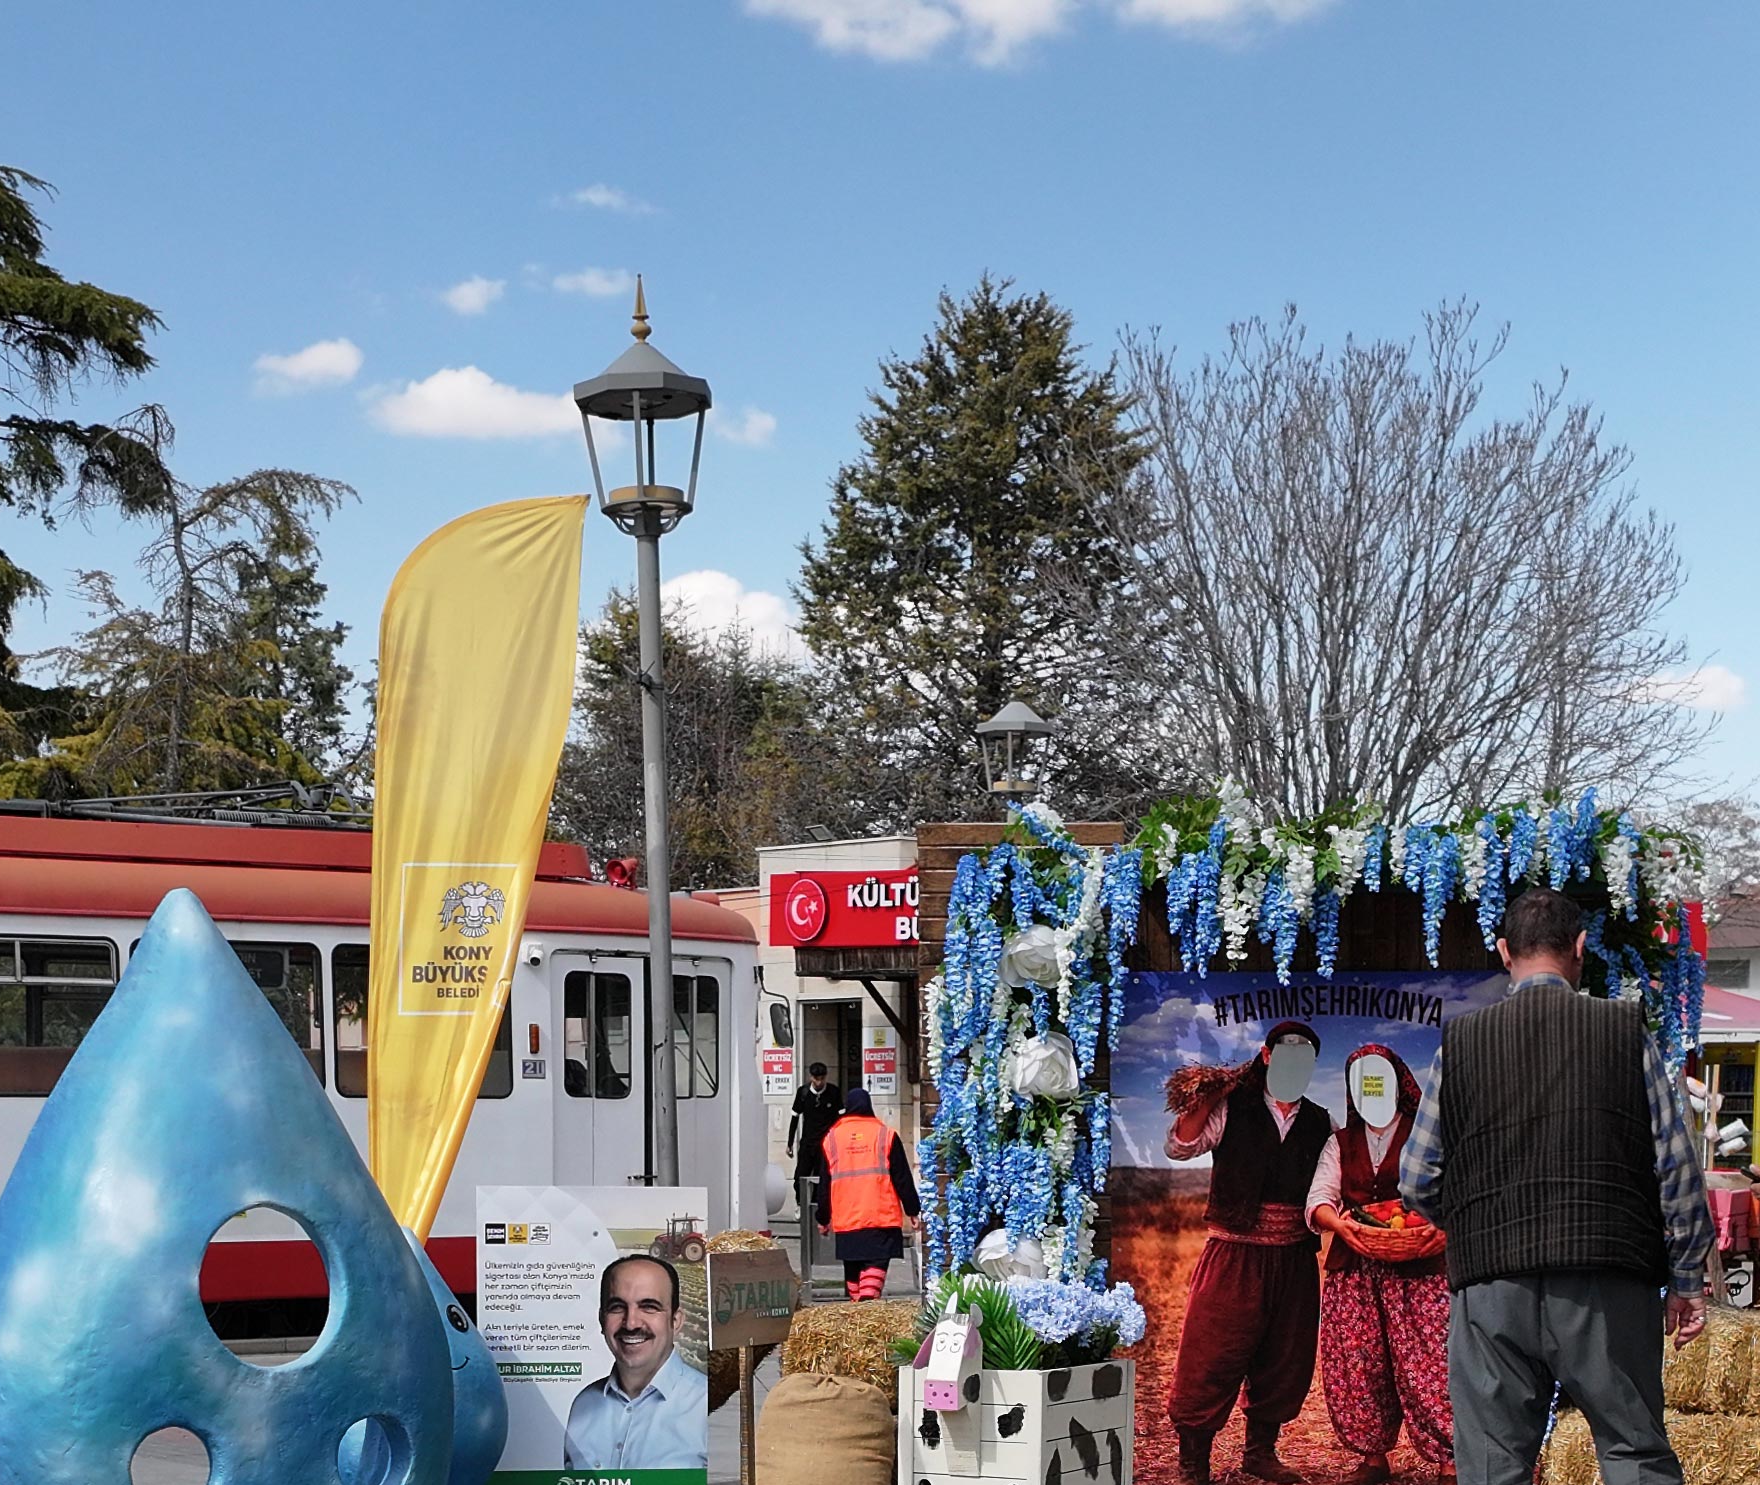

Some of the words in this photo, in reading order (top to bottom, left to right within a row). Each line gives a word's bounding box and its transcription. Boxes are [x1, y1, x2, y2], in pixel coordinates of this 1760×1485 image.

[847, 875, 919, 908] KÜLTÜ
[443, 946, 493, 961] KONY
[437, 985, 480, 998] BELEDİ
[1214, 983, 1442, 1028] #TARIMŞEHRİKONYA
[734, 1281, 791, 1310] TARIM
[513, 1364, 552, 1374] İBRAHİM
[553, 1365, 581, 1373] ALTAY
